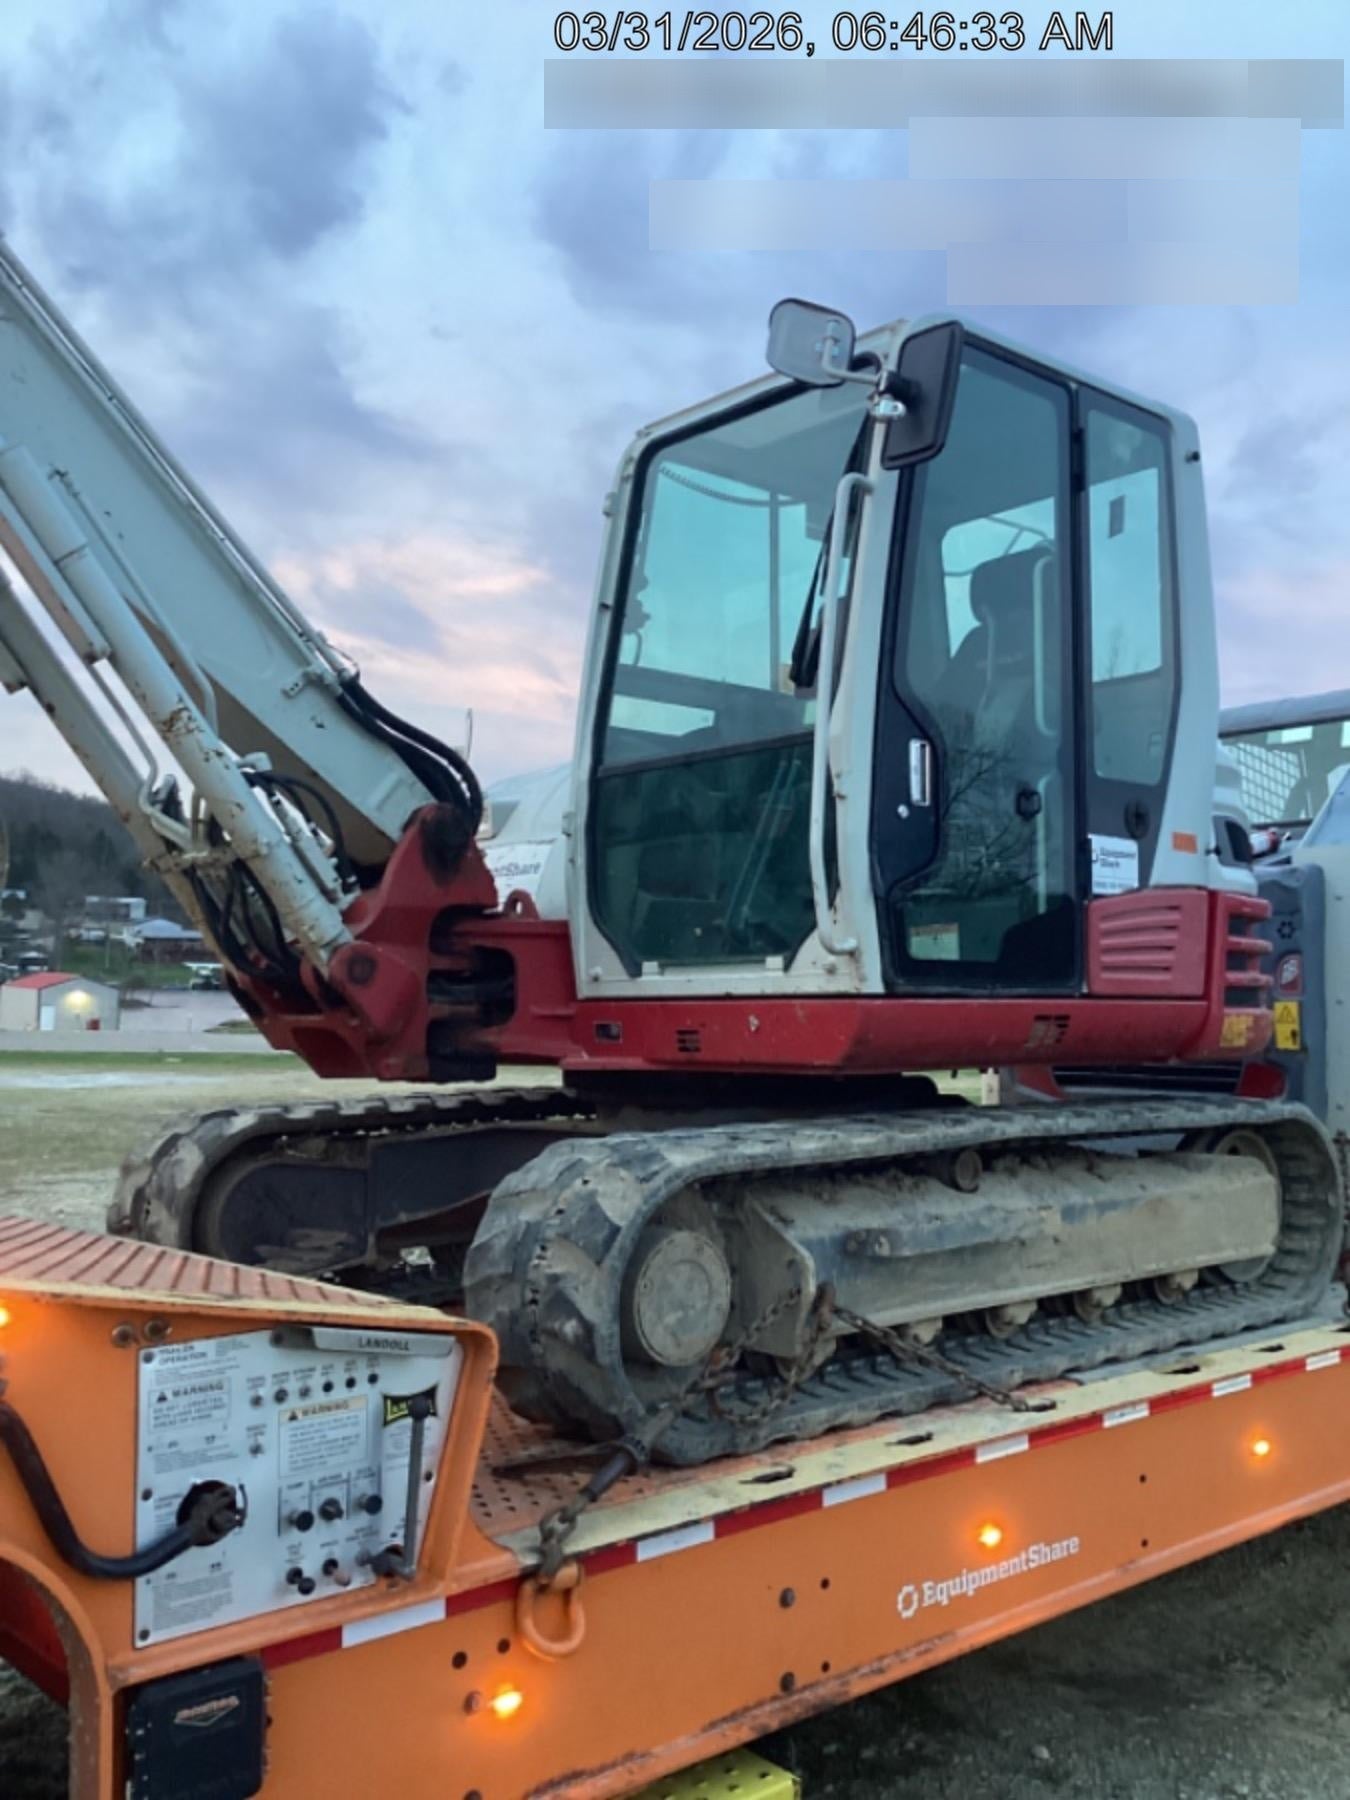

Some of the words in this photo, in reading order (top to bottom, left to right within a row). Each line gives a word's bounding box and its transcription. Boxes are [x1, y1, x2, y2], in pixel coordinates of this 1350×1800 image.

[172, 1381, 224, 1398] WARNING
[302, 1400, 349, 1416] WARNING
[922, 1536, 1080, 1607] EquipmentShare
